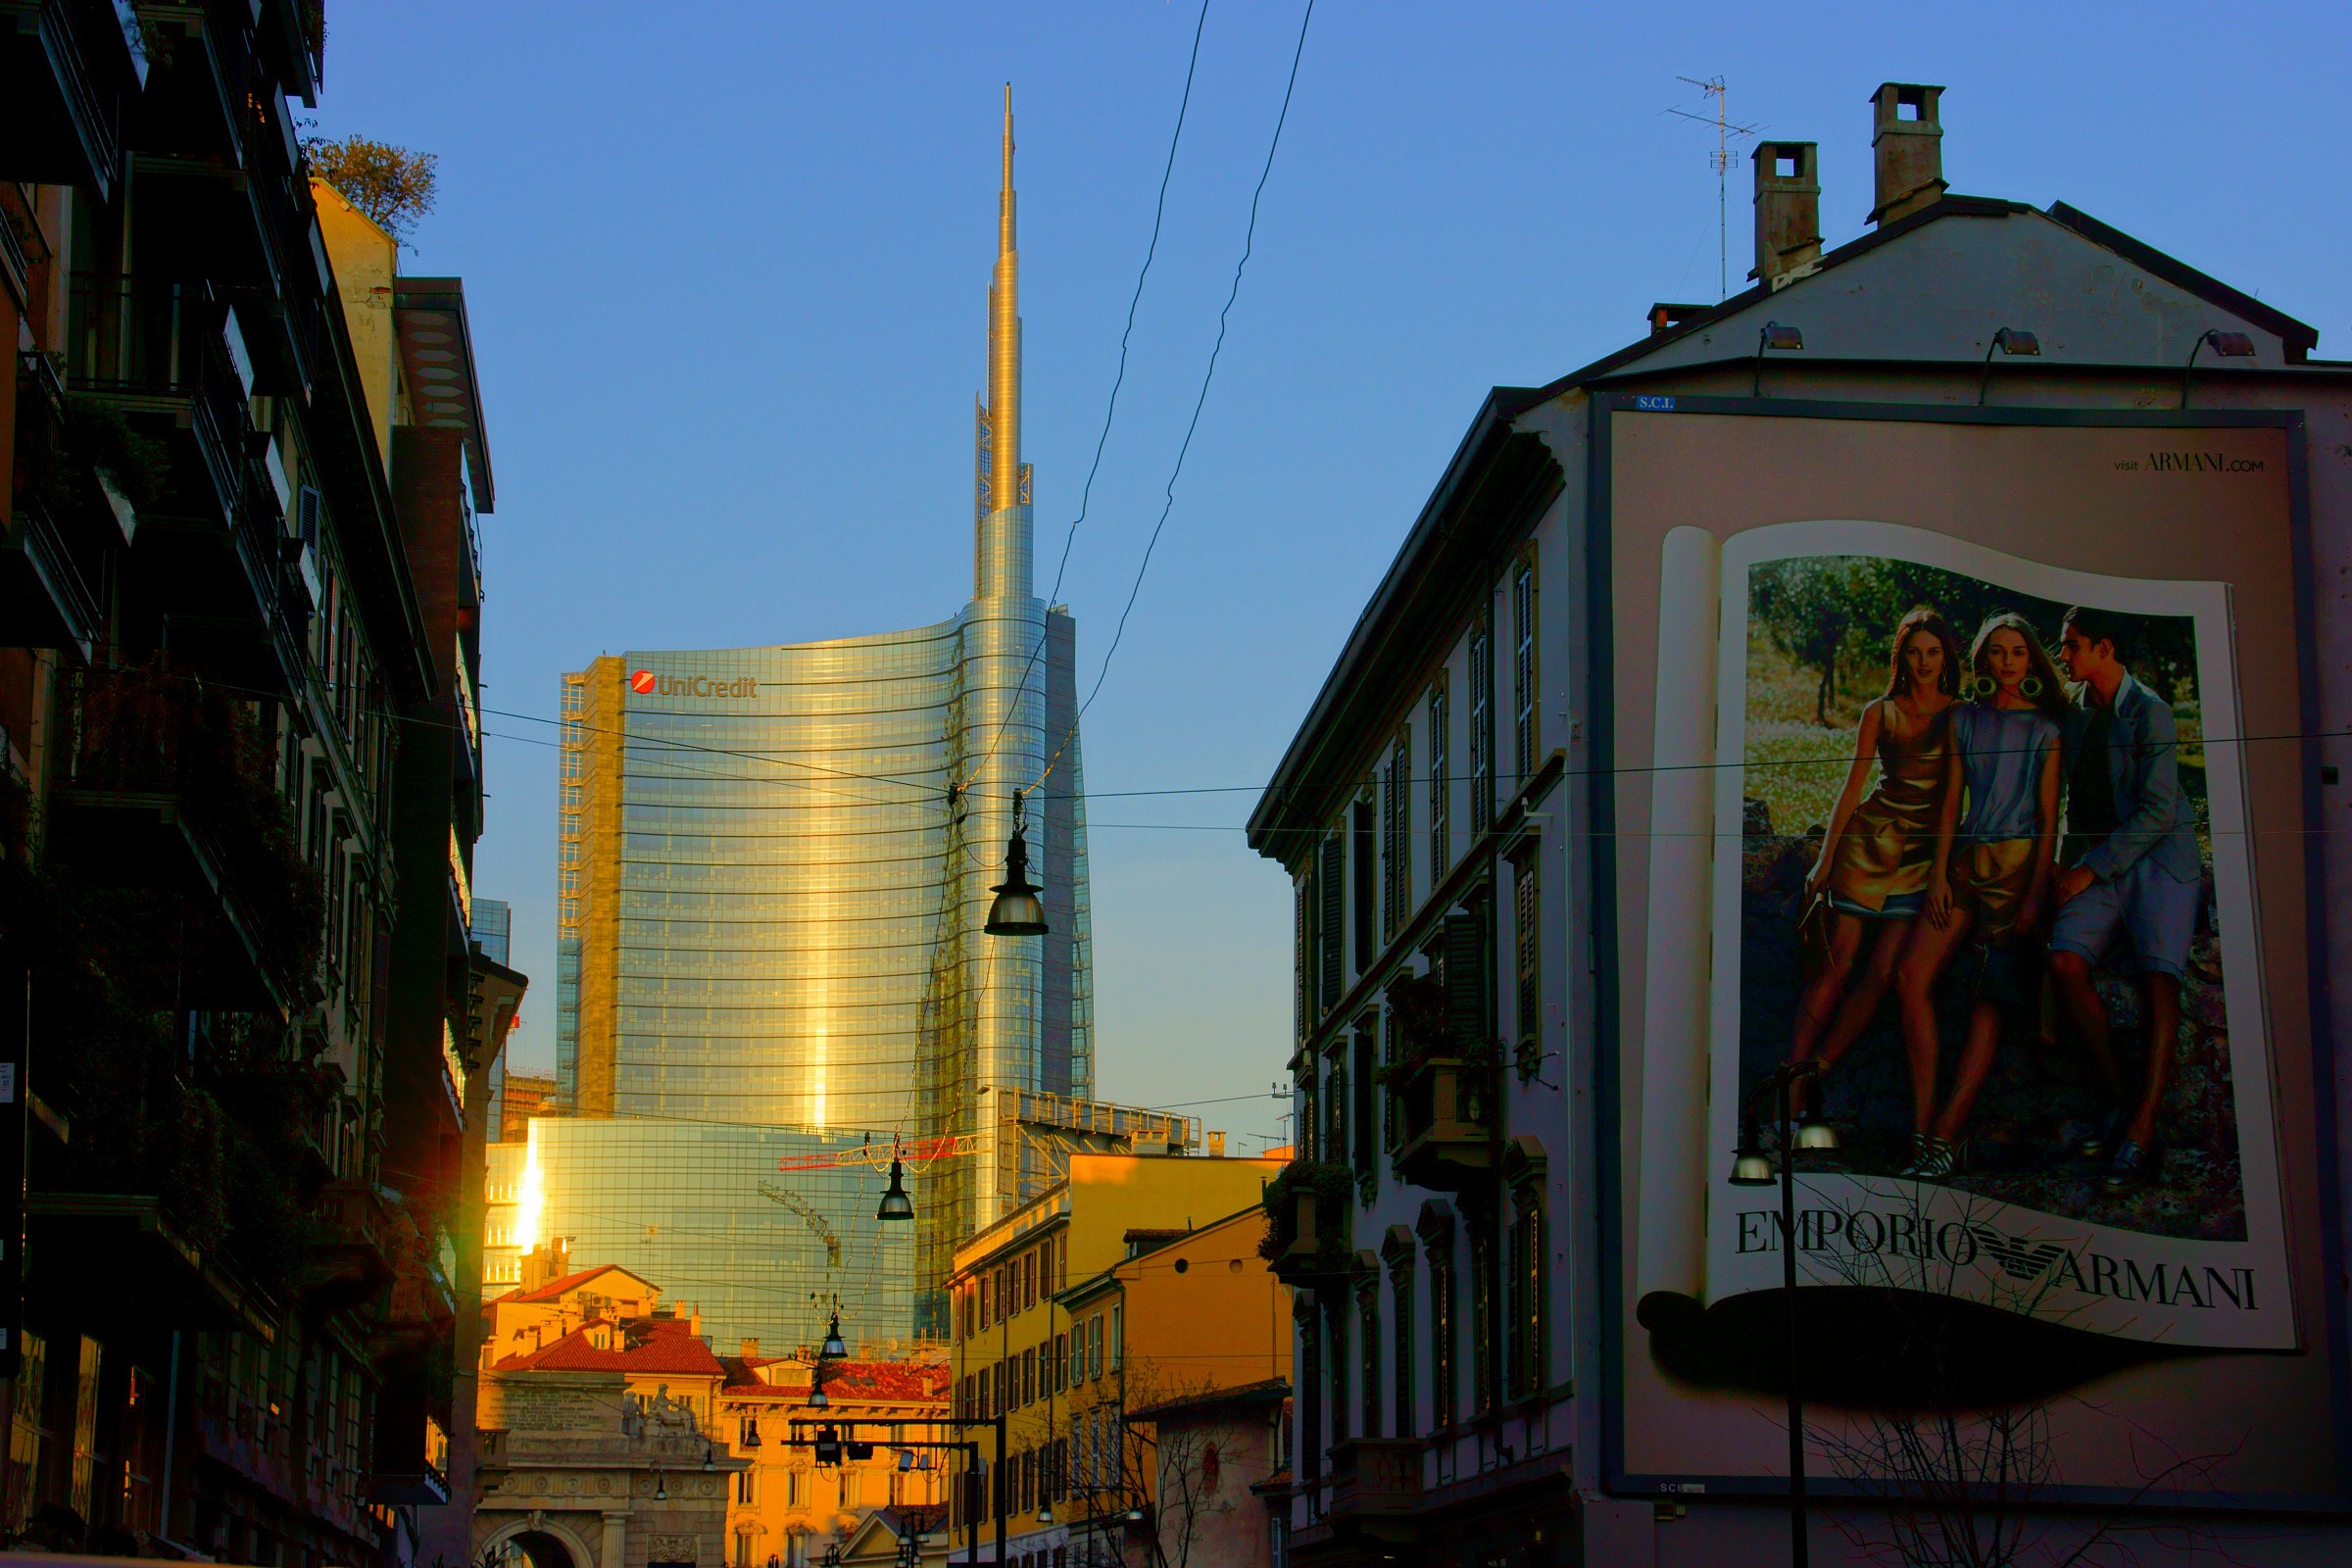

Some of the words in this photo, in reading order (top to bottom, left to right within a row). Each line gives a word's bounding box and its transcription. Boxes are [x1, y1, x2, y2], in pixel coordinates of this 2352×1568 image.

[1640, 397, 1674, 409] S.C.I.
[2114, 461, 2138, 470] visit
[2145, 453, 2264, 472] ARMANI.COM
[659, 674, 757, 698] UniCredit
[1736, 1209, 1978, 1266] EMPORIO
[2051, 1249, 2259, 1310] ARMANI
